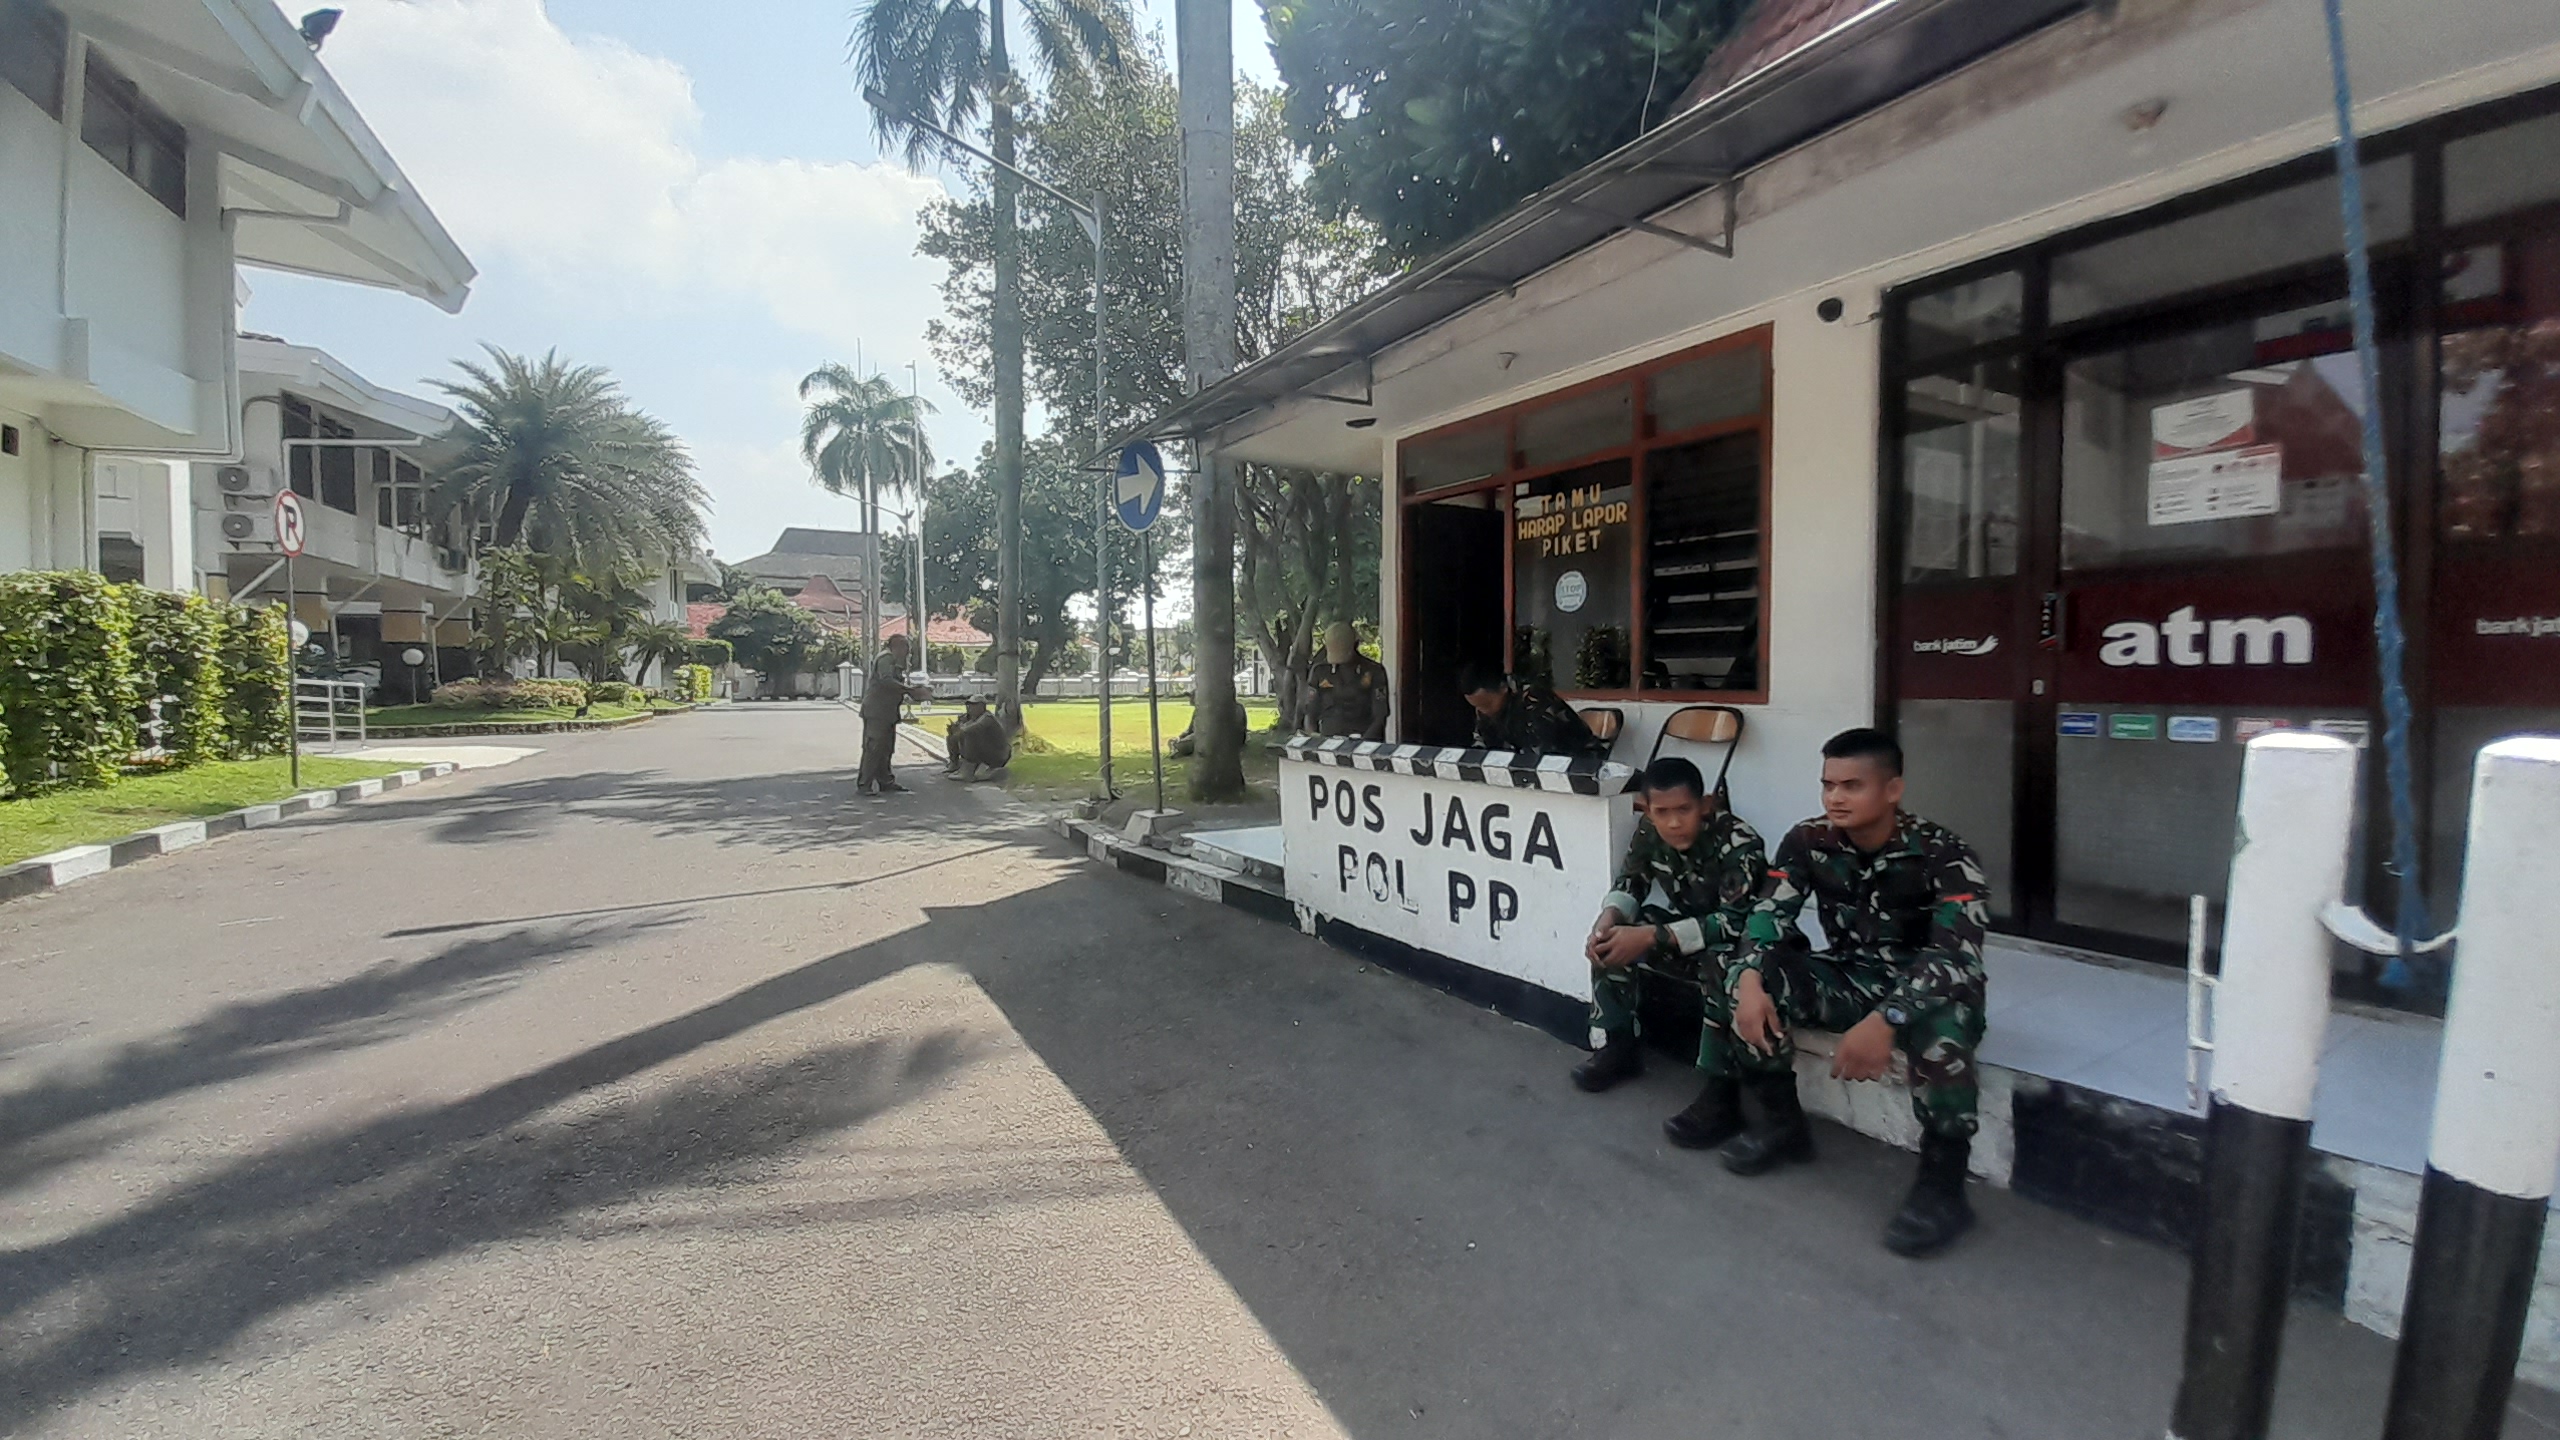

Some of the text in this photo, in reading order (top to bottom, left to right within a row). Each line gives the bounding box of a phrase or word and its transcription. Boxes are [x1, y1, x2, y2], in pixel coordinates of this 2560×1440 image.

[1541, 483, 1601, 514] TAMU
[284, 504, 298, 541] P
[1518, 501, 1628, 540] HARAP LAPOR
[1542, 529, 1601, 558] PIKET
[2099, 605, 2312, 666] atm
[2476, 617, 2530, 635] bank
[1913, 640, 1941, 652] bank
[1309, 774, 1565, 871] POS JAGA
[1338, 844, 1519, 940] POL PP
